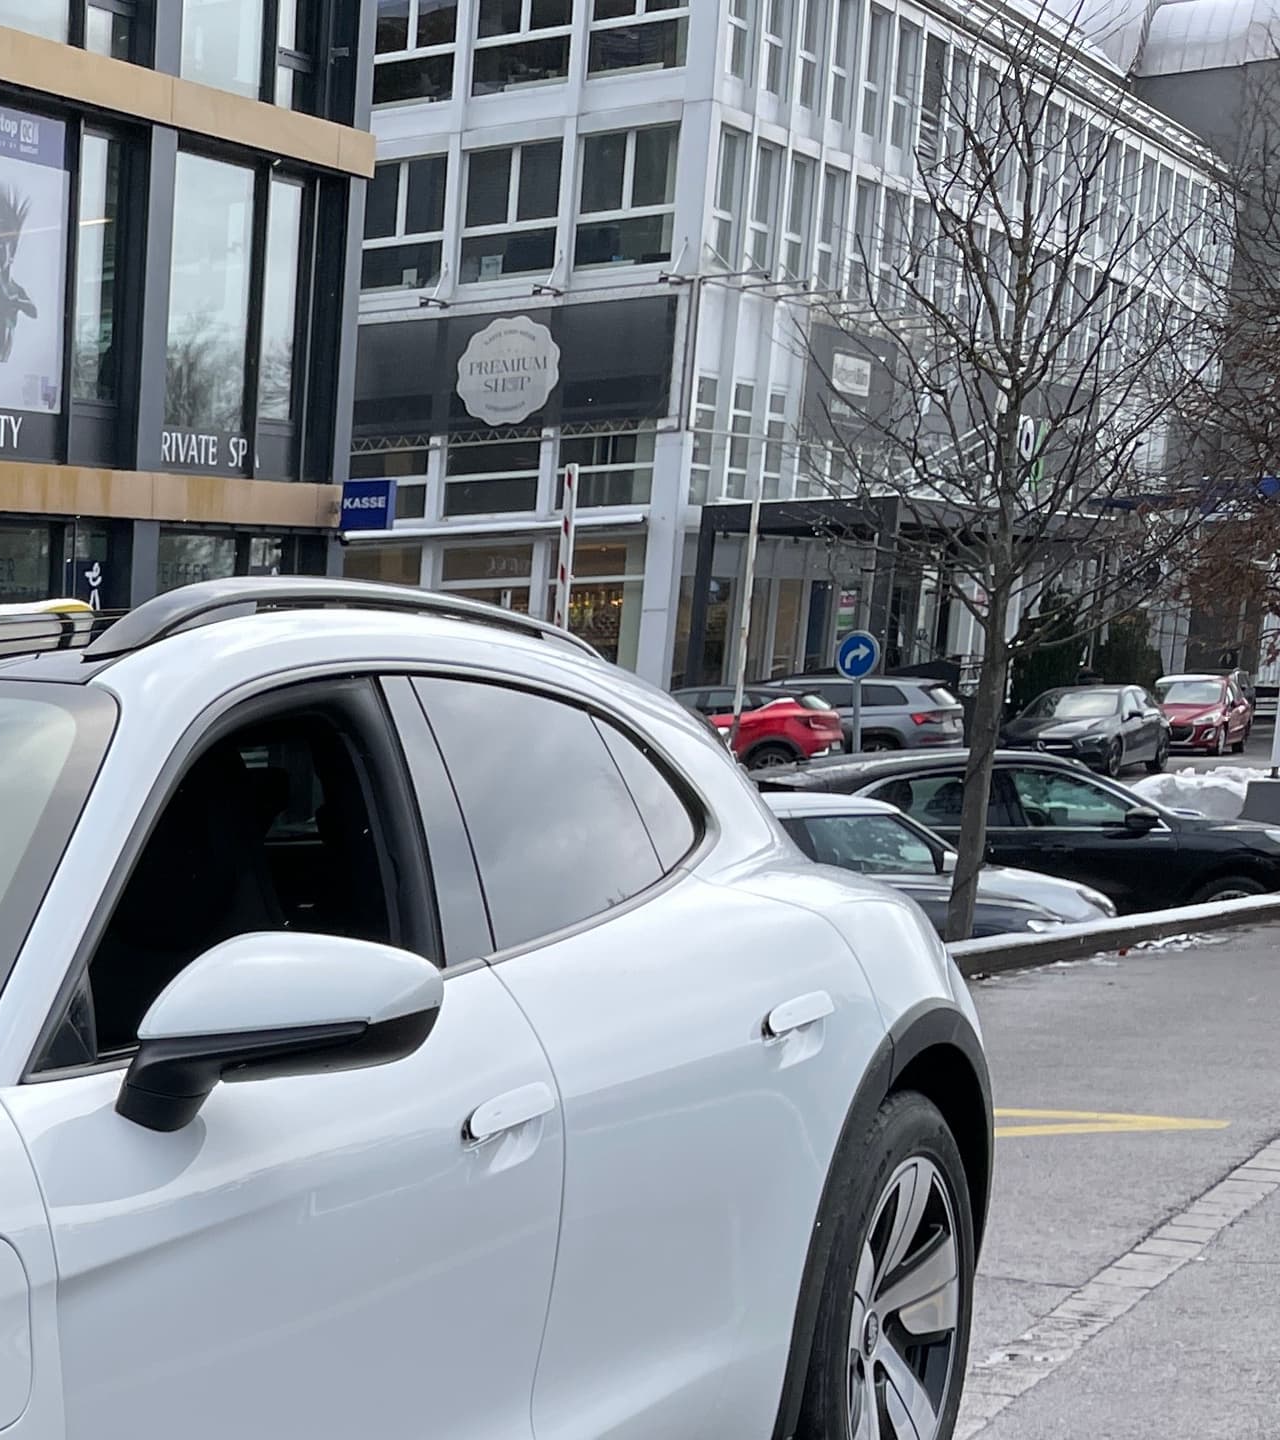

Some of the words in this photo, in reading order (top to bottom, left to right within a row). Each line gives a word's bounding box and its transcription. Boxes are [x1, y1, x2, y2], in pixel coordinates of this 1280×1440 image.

[469, 356, 548, 376] PREMIUM
[161, 431, 218, 466] RIVATE
[228, 437, 260, 469] SP
[343, 495, 386, 510] KASSE
